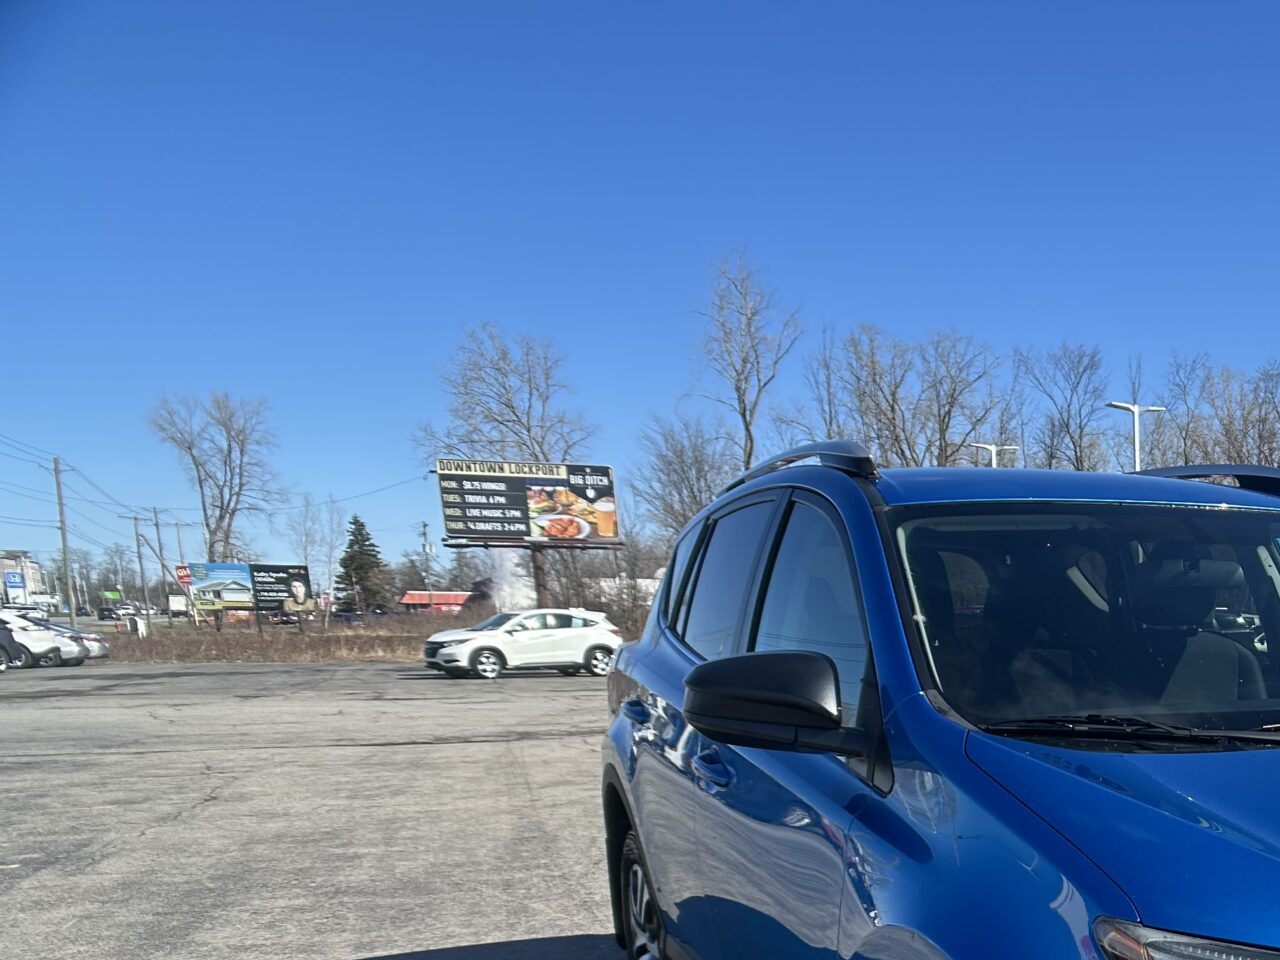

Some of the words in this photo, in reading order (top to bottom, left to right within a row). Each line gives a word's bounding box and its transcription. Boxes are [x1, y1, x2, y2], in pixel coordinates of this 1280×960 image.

[439, 460, 504, 473] DOWNTOWN
[509, 463, 561, 476] LOCKPORT
[569, 475, 584, 485] BIG
[585, 475, 609, 486] DITCH
